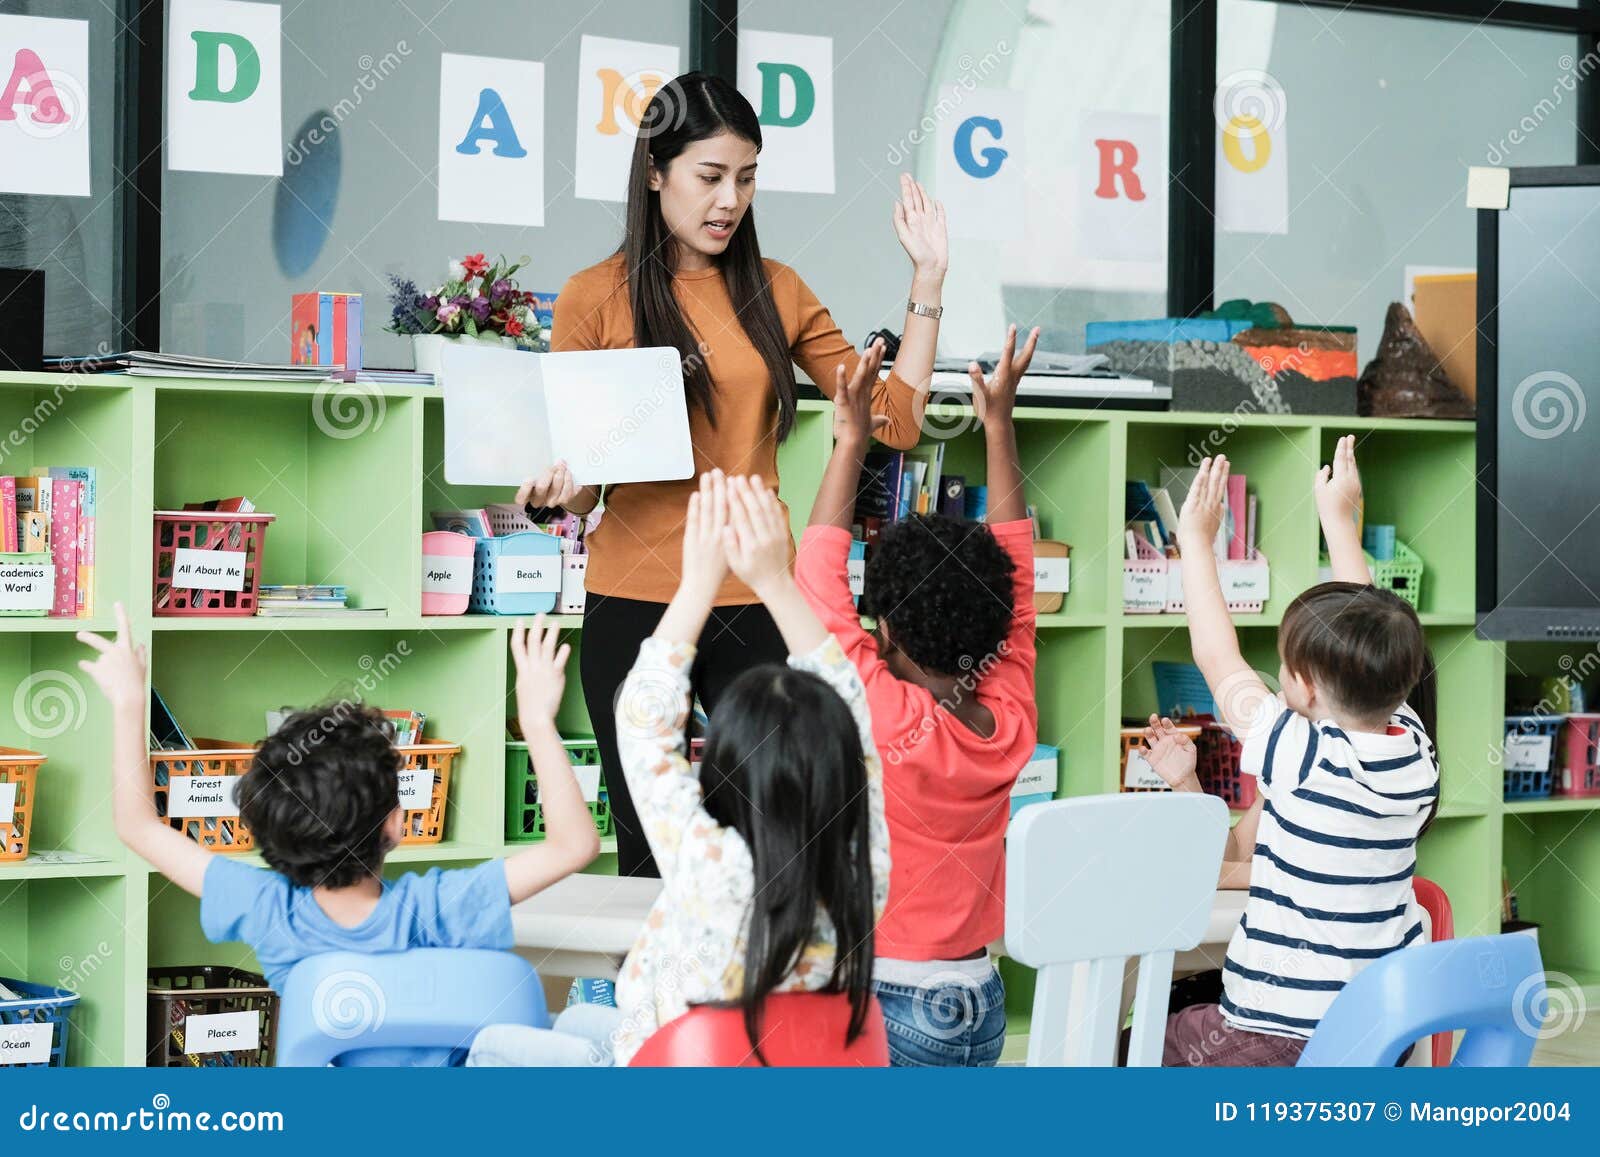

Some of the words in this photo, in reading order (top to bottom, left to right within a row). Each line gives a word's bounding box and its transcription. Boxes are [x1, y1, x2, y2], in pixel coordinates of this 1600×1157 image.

[188, 31, 261, 103] D
[0, 48, 71, 124] A
[757, 62, 816, 128] D
[456, 88, 528, 159] A
[953, 116, 1009, 179] G
[1222, 113, 1272, 174] O
[1095, 139, 1147, 201] R
[0, 569, 44, 578] cademics
[179, 564, 191, 574] All
[195, 564, 222, 575] About
[226, 567, 240, 577] Me
[427, 570, 452, 581] Apple
[517, 570, 542, 579] Beach
[5, 583, 32, 592] Word
[190, 780, 222, 789] Forest
[397, 787, 416, 796] mals
[188, 793, 223, 803] Animals
[207, 1029, 237, 1039] Places
[1, 1040, 31, 1049] Ocean
